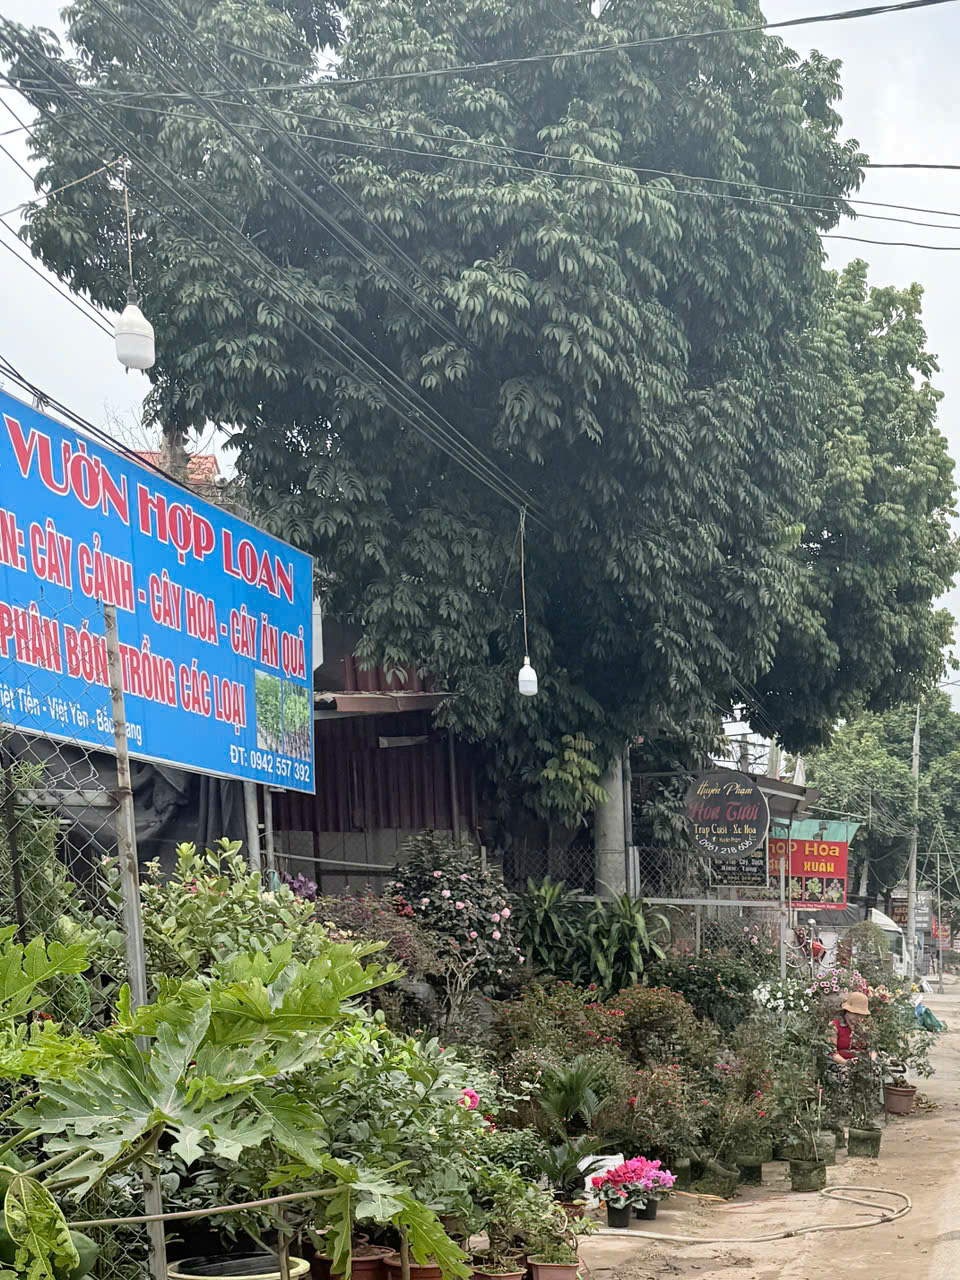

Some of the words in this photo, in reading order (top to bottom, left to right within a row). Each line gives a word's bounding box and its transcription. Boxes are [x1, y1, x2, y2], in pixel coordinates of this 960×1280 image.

[3, 413, 129, 526] VƯỜN
[137, 482, 215, 565] HỢP
[222, 528, 293, 604] LOAN
[30, 516, 72, 590] CÂY
[78, 532, 135, 614] CẢNH
[149, 568, 182, 632] CÂY
[185, 587, 218, 646] HOA
[229, 603, 257, 661] CÂY
[260, 612, 279, 669] ĂN
[281, 624, 306, 680] QUẢ
[0, 601, 63, 674] PHÂN
[118, 634, 178, 708] TRỒNG
[179, 658, 211, 717] CÁC
[213, 674, 247, 735] LOẠI
[0, 683, 15, 714] iệt
[47, 695, 69, 728] Việt
[69, 701, 90, 728] Yên
[230, 744, 247, 766] ĐT:
[250, 751, 273, 773] 0942
[276, 757, 292, 777] 557
[294, 763, 310, 782] 392
[803, 859, 835, 873] XUÂN
[804, 842, 840, 857] Hoa
